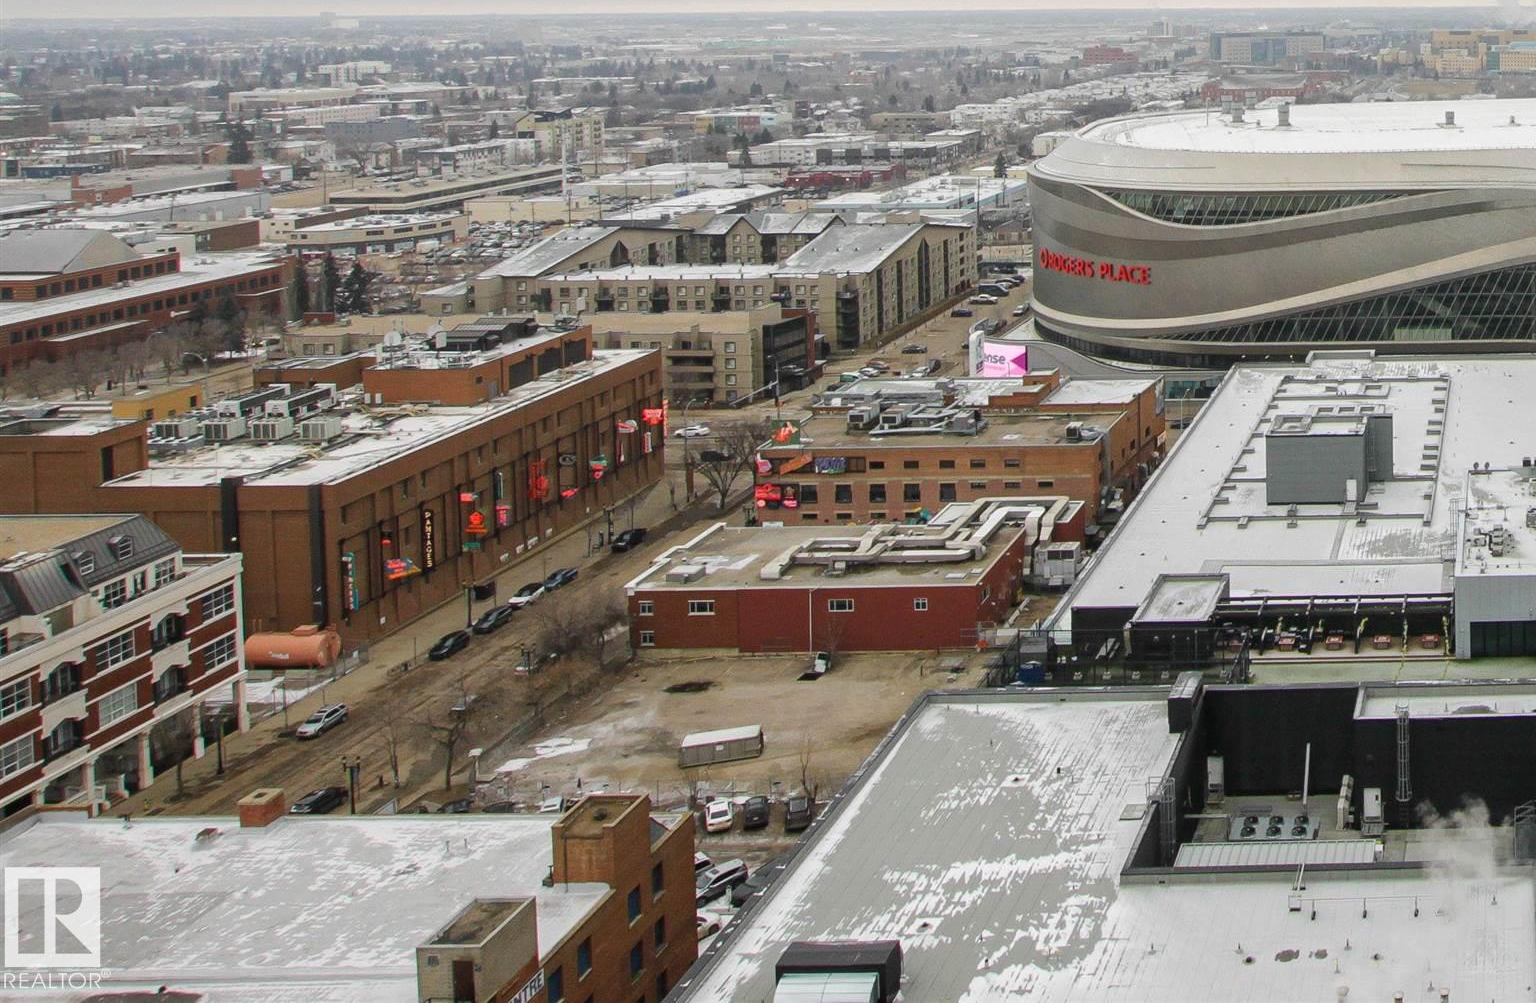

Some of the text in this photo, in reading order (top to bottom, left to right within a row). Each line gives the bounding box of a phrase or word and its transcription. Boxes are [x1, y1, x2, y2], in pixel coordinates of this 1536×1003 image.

[1047, 253, 1152, 286] ROGERS PLACE
[423, 511, 433, 568] PANTAGES
